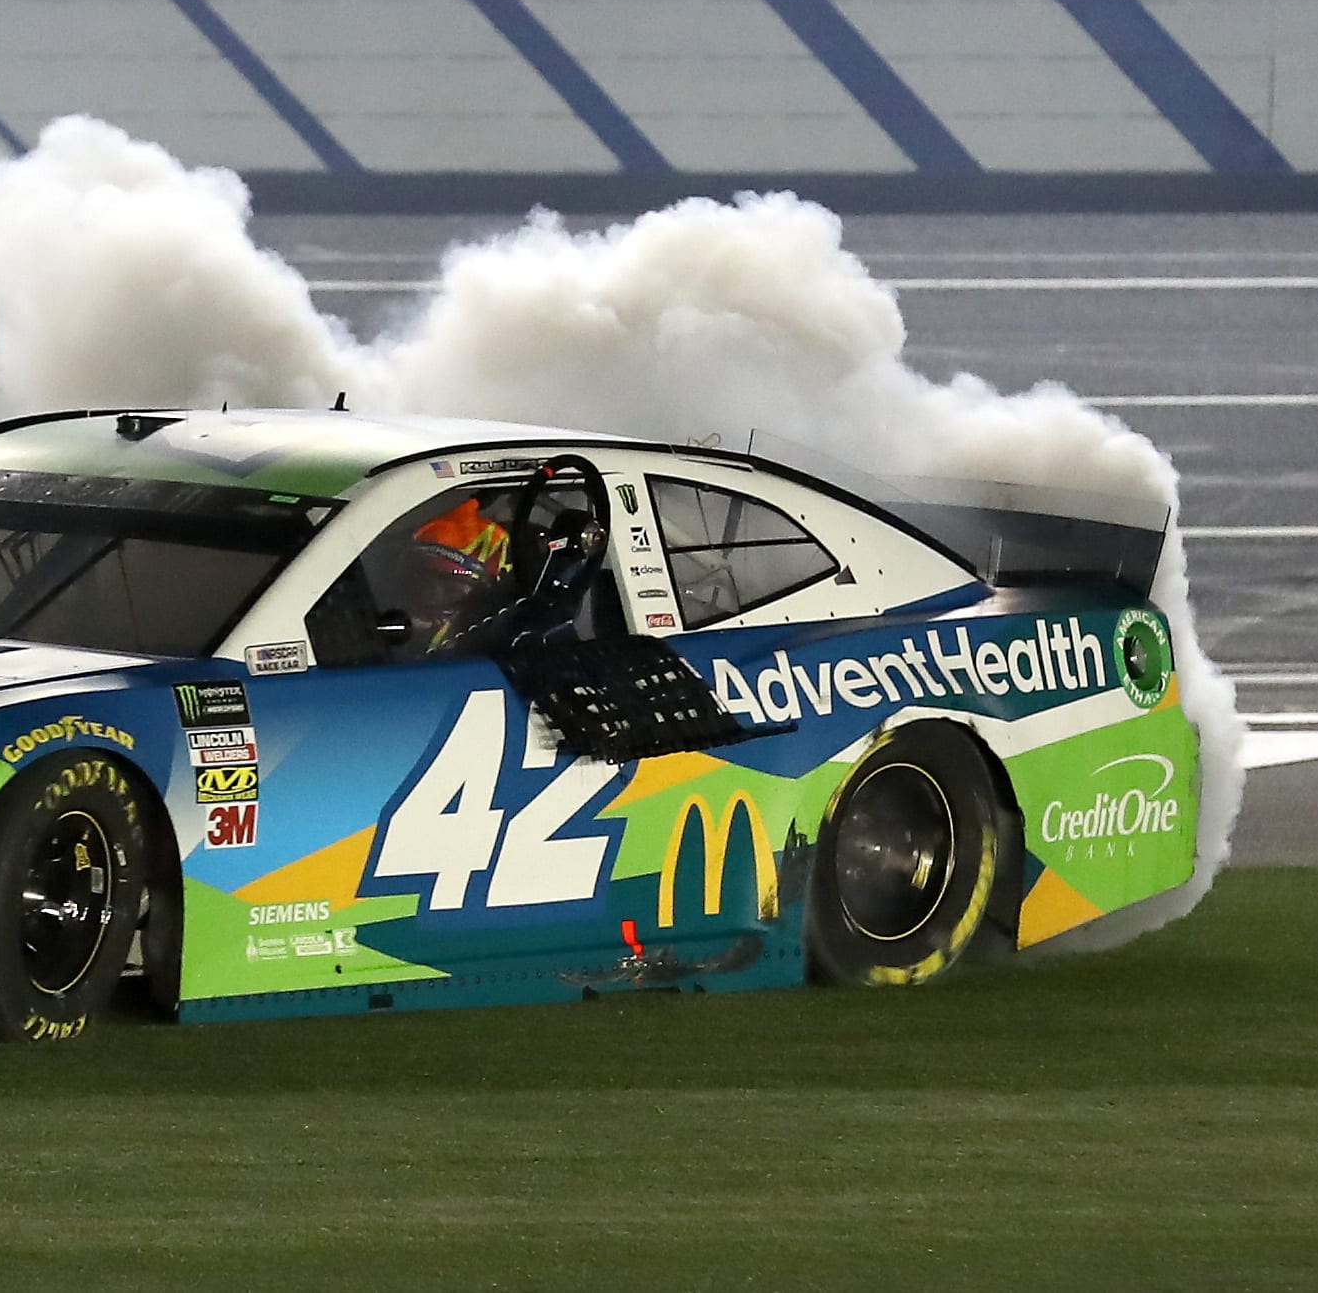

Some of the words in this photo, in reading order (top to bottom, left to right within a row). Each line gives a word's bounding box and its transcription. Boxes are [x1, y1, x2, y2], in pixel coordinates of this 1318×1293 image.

[1116, 610, 1166, 651] AMERICAN
[256, 661, 279, 672] RACE
[281, 660, 300, 671] CAR
[709, 617, 1107, 724] AdventHealth
[2, 715, 135, 762] GOODYEAR
[190, 732, 243, 748] LINCOLN
[204, 748, 251, 762] WELDERS
[374, 689, 623, 910] 42
[207, 804, 256, 846] 3M
[1066, 841, 1135, 863] BANK
[248, 901, 330, 925] SIEMENS
